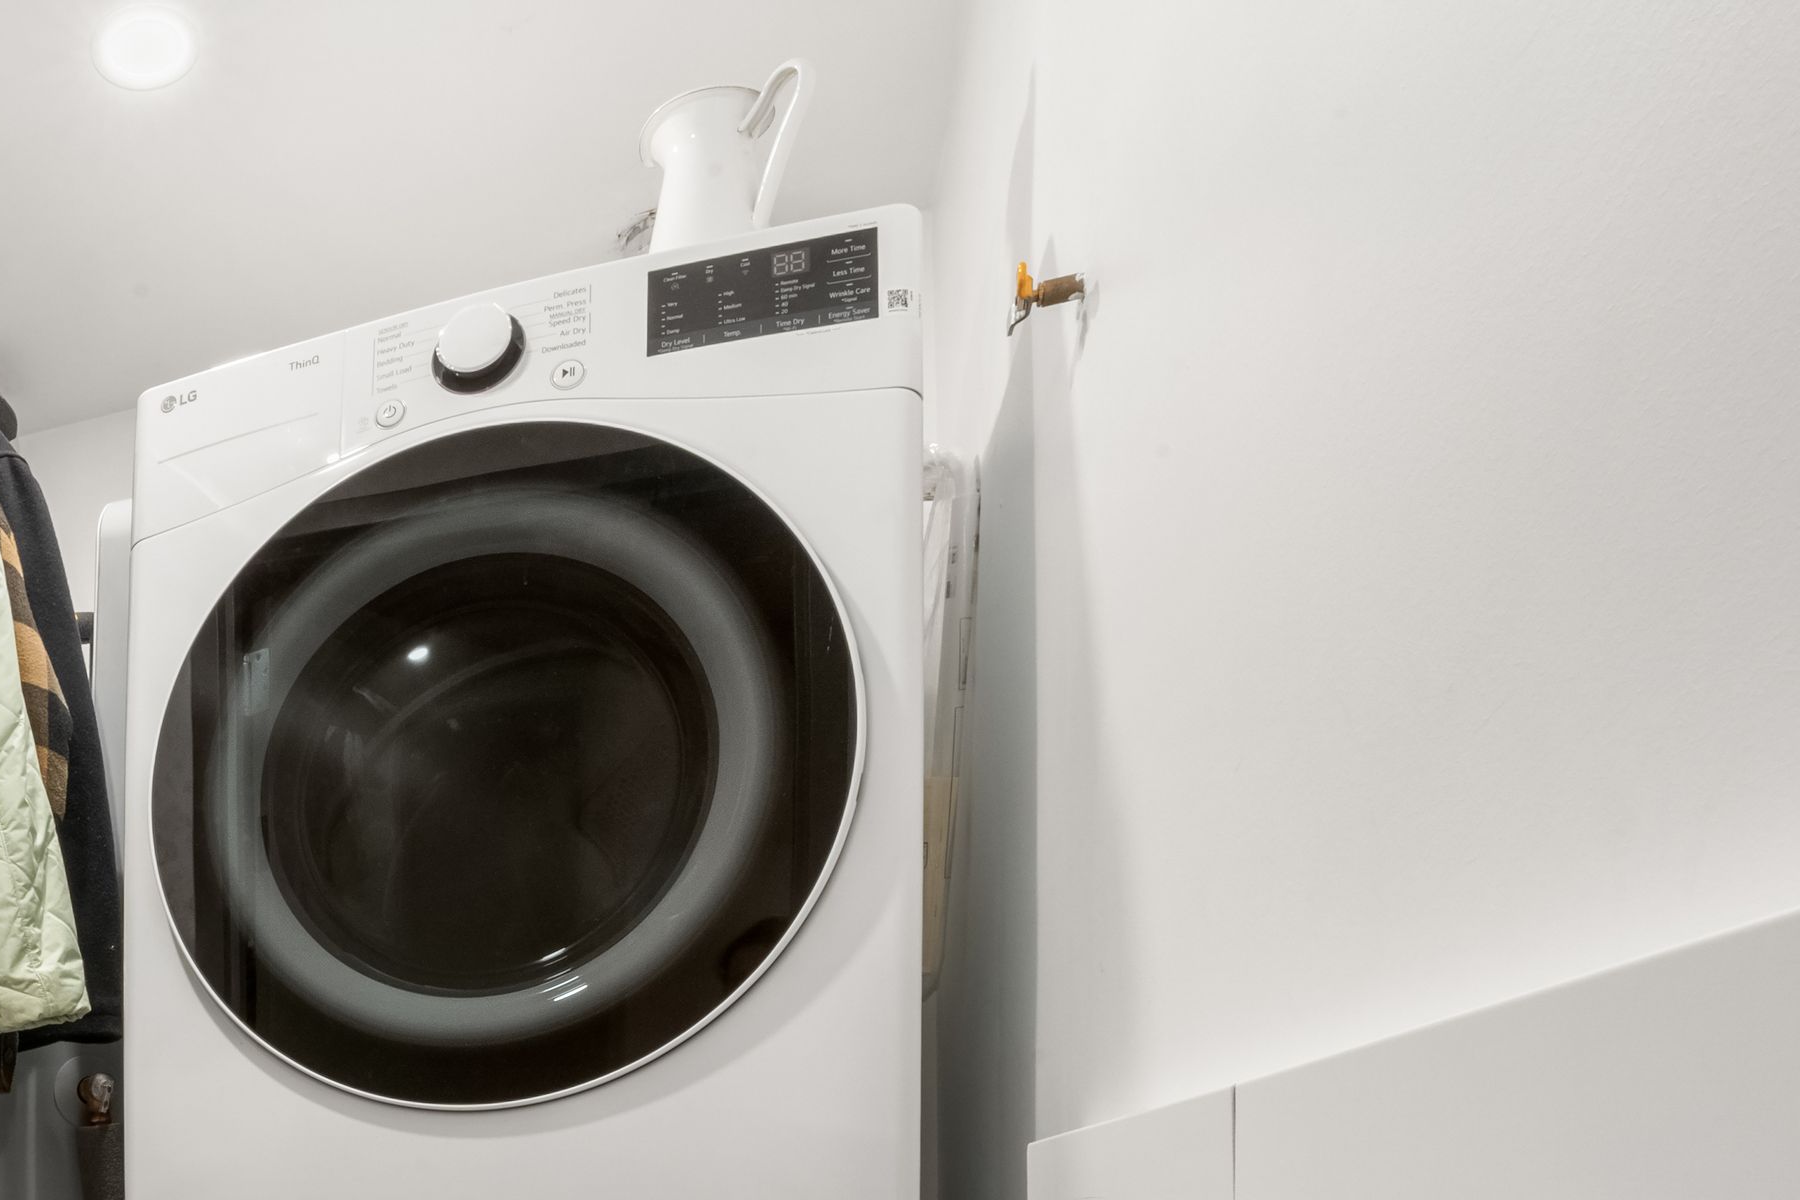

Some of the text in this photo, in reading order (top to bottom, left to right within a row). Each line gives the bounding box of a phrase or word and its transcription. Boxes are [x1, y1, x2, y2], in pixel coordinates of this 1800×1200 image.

[831, 243, 866, 256] More Time
[832, 266, 866, 277] Less Time
[553, 287, 587, 299] Delicates
[829, 286, 871, 299] Wrinkle Care
[828, 307, 871, 320] Energy Saver
[548, 315, 586, 328] Speed Dry
[775, 317, 805, 328] Time Dry
[573, 327, 586, 335] Dry
[541, 339, 586, 354] Downloaded
[661, 337, 691, 349] Dry Level
[288, 354, 321, 372] ThinQ
[178, 390, 198, 406] LG
